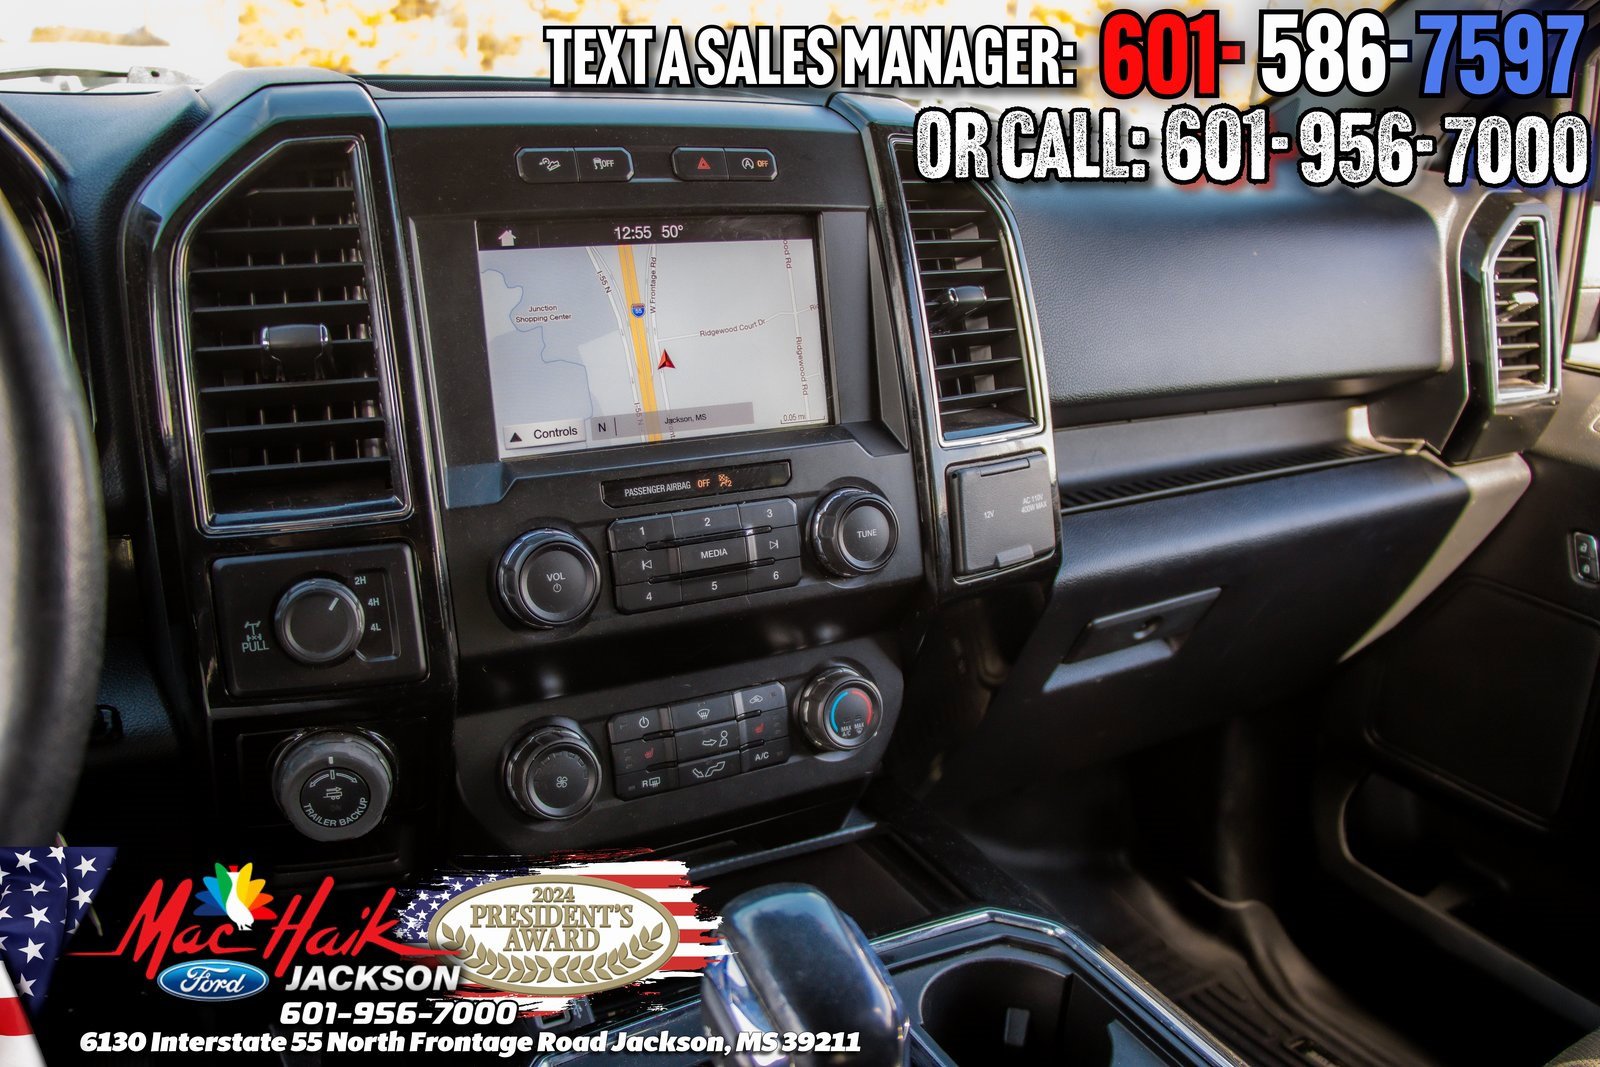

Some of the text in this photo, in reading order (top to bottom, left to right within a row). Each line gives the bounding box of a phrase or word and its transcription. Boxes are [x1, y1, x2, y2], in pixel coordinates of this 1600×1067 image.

[601, 159, 615, 168] OFF
[757, 160, 769, 168] OFF
[614, 224, 684, 240] 12:55 50°
[650, 256, 657, 268] Rd
[785, 257, 793, 269] Rd
[597, 270, 612, 294] I-55 N
[528, 305, 558, 313] Junction
[650, 305, 657, 314] W
[515, 313, 572, 324] Shopping Center
[700, 325, 738, 337] Ridgewood
[739, 321, 757, 331] Court
[795, 336, 809, 396] Ridgewood Rd
[664, 413, 707, 425] Jackson, MS
[598, 422, 607, 432] N
[533, 425, 578, 440] Controls
[624, 484, 665, 497] PASSENGER
[666, 480, 691, 492] AIRBAG
[697, 478, 711, 488] OFF
[766, 508, 773, 518] 3
[984, 509, 995, 519] 12V
[704, 517, 711, 527] 2
[639, 526, 645, 536] 1
[856, 528, 878, 539] TUNE
[700, 547, 728, 560] MEDIA
[354, 575, 367, 585] 2H
[546, 572, 566, 582] VOL
[772, 570, 779, 580] 6
[711, 581, 718, 591] 5
[368, 597, 380, 606] 4H
[645, 592, 653, 602] 4
[370, 623, 382, 632] 4L
[241, 640, 270, 653] PULL
[754, 752, 770, 761] A/C
[303, 797, 368, 826] TRAILER BACKUP
